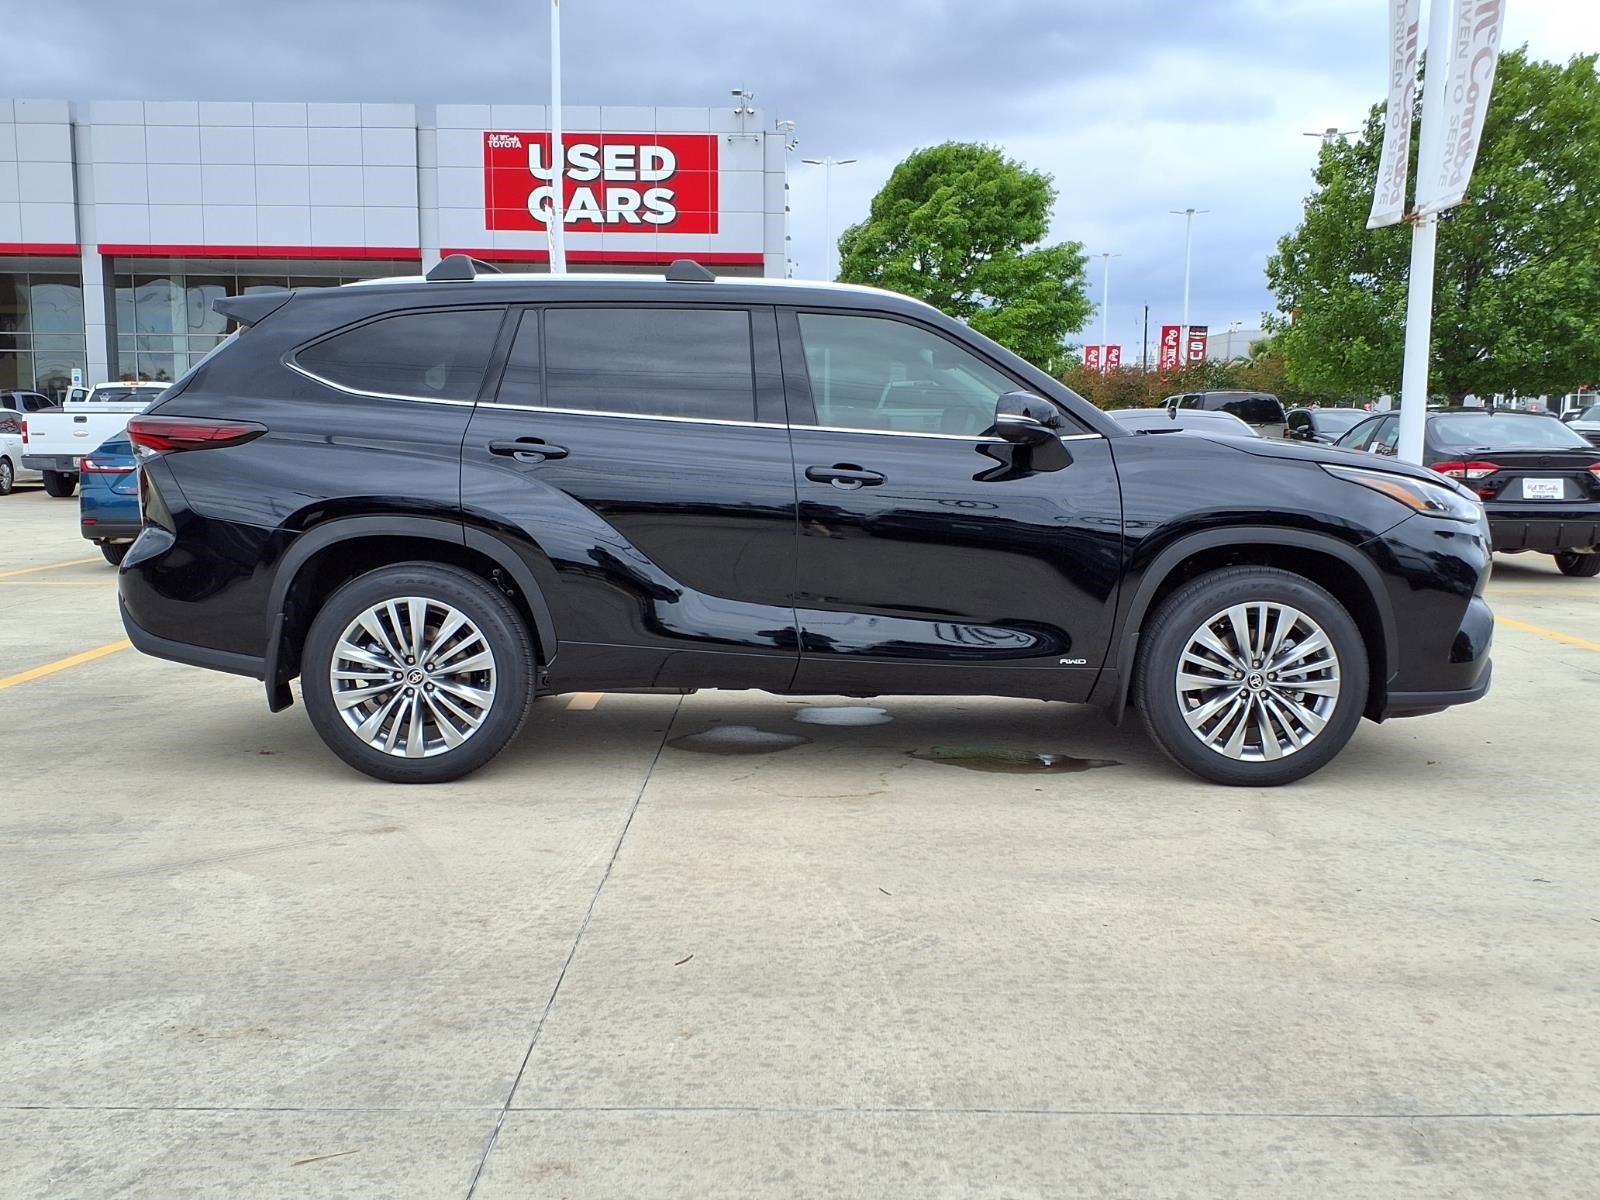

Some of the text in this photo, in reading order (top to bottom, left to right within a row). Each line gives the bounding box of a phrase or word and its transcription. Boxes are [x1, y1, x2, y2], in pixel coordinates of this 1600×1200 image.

[1378, 4, 1406, 206] DRIVEN TO SERVE
[1439, 0, 1473, 188] IVEN TO SERVE
[488, 140, 522, 149] TOYOTA
[528, 143, 676, 182] USED
[527, 185, 677, 225] CARS
